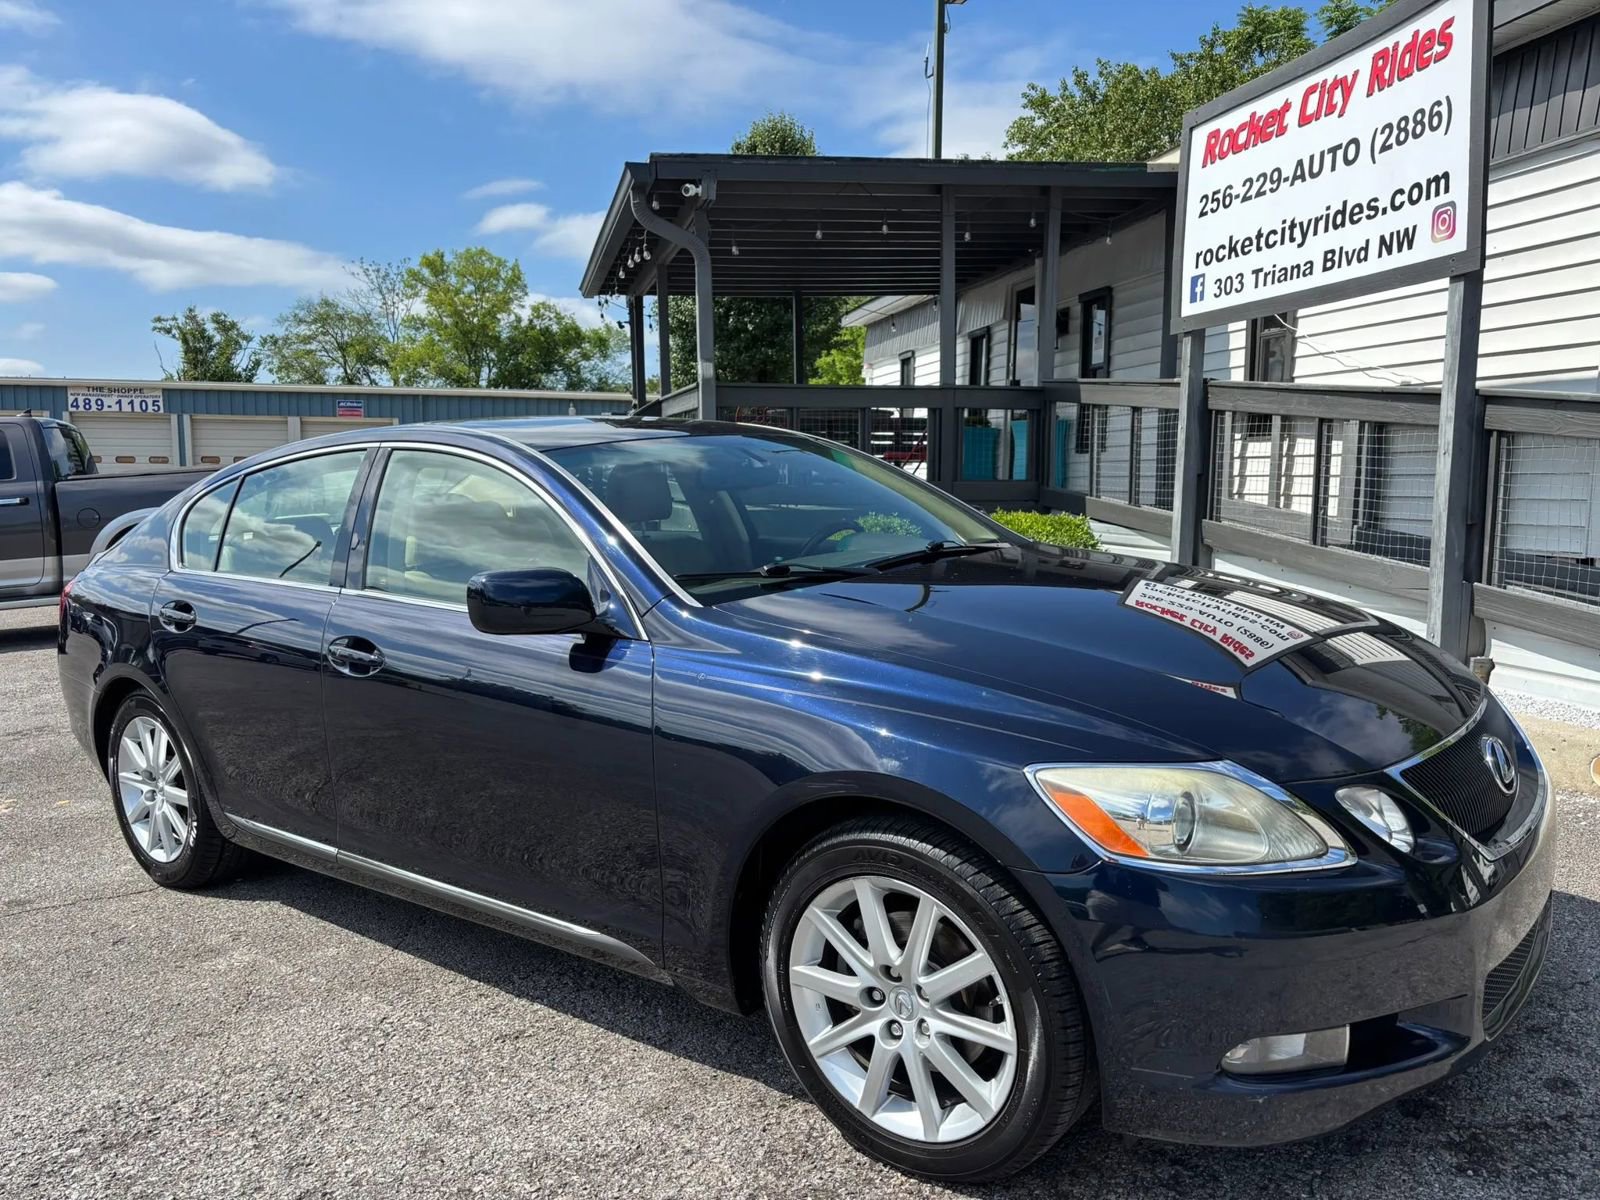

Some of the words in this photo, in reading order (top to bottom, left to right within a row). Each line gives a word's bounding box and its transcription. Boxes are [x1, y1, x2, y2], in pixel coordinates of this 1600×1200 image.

[1202, 97, 1293, 168] Rocket
[1298, 69, 1360, 128] City
[1366, 16, 1455, 98] Rides
[1198, 137, 1361, 218] 256-229-AUTO
[1370, 95, 1452, 164] (2886)
[1195, 170, 1450, 269] rocketcityrides.com
[1213, 273, 1244, 299] 303
[1251, 259, 1314, 289] Triana
[1322, 239, 1370, 273] Blvd
[1377, 224, 1418, 259] NW
[70, 397, 161, 413] 489-1105
